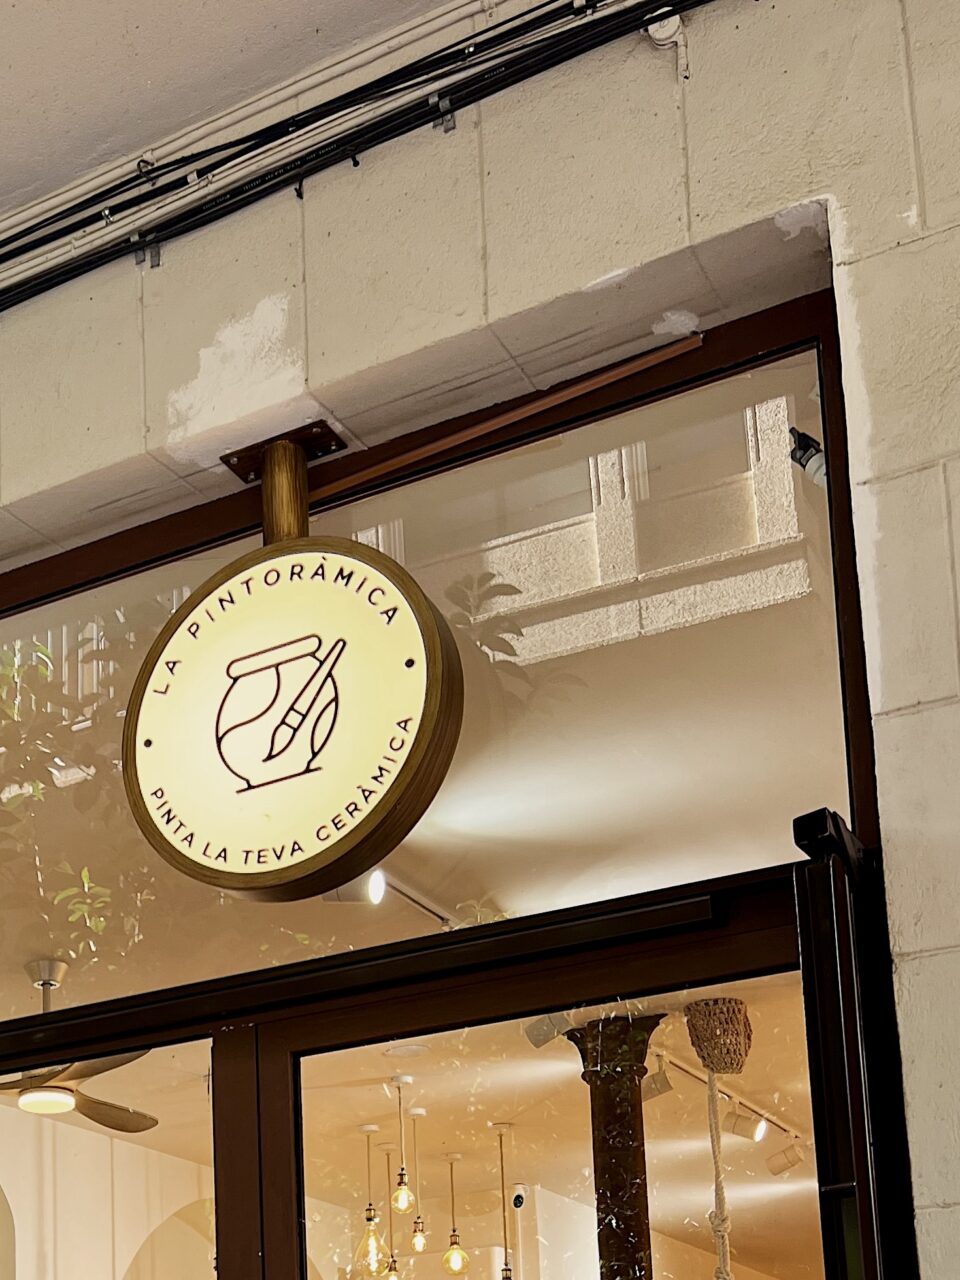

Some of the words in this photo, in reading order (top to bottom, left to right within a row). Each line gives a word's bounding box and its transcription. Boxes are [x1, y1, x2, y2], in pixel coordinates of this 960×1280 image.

[153, 658, 182, 696] LA
[187, 556, 399, 640] PINTORÀMICA
[151, 788, 195, 848] PINTA
[202, 842, 228, 863] LA
[242, 840, 304, 865] TEVA
[316, 716, 413, 842] CERÀMICA
